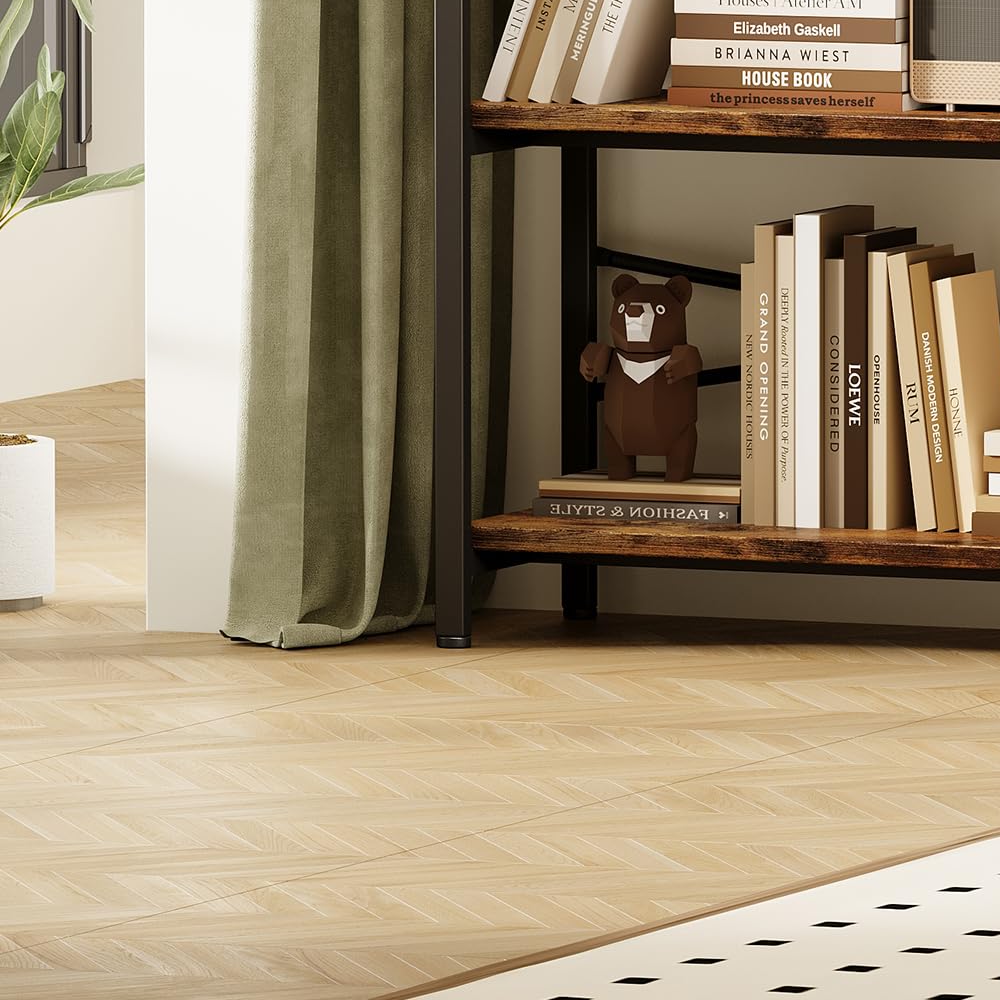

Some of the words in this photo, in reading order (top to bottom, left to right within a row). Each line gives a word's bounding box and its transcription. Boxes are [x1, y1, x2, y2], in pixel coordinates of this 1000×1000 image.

[602, 13, 619, 34] THE
[733, 20, 791, 35] Elizabeth
[794, 23, 841, 37] Gaskell
[714, 46, 791, 62] BRIANNA
[800, 49, 850, 63] WIEST
[741, 70, 789, 87] HOUSE
[793, 72, 833, 88] BOOK
[710, 92, 732, 104] the
[734, 93, 790, 107] princess
[791, 96, 827, 106] saves
[828, 95, 876, 107] herself
[759, 292, 769, 354] GRAND
[781, 287, 789, 323] DEEPLY
[745, 334, 753, 361] NEW
[781, 324, 789, 357] Rooted
[921, 331, 933, 373] DANISH
[781, 357, 789, 368] IN
[781, 370, 789, 390] THE
[745, 364, 753, 412] NORDIC
[759, 361, 769, 441] OPENING
[829, 335, 840, 453] CONSIDERED
[848, 363, 861, 427] LOEWE
[873, 354, 881, 425] OPENHOUSE
[906, 381, 920, 425] RUM
[927, 374, 939, 422] MODERN
[781, 393, 789, 428] POWER
[745, 415, 753, 460] HOUSES
[781, 430, 789, 445] OF
[932, 423, 943, 463] DESIGN
